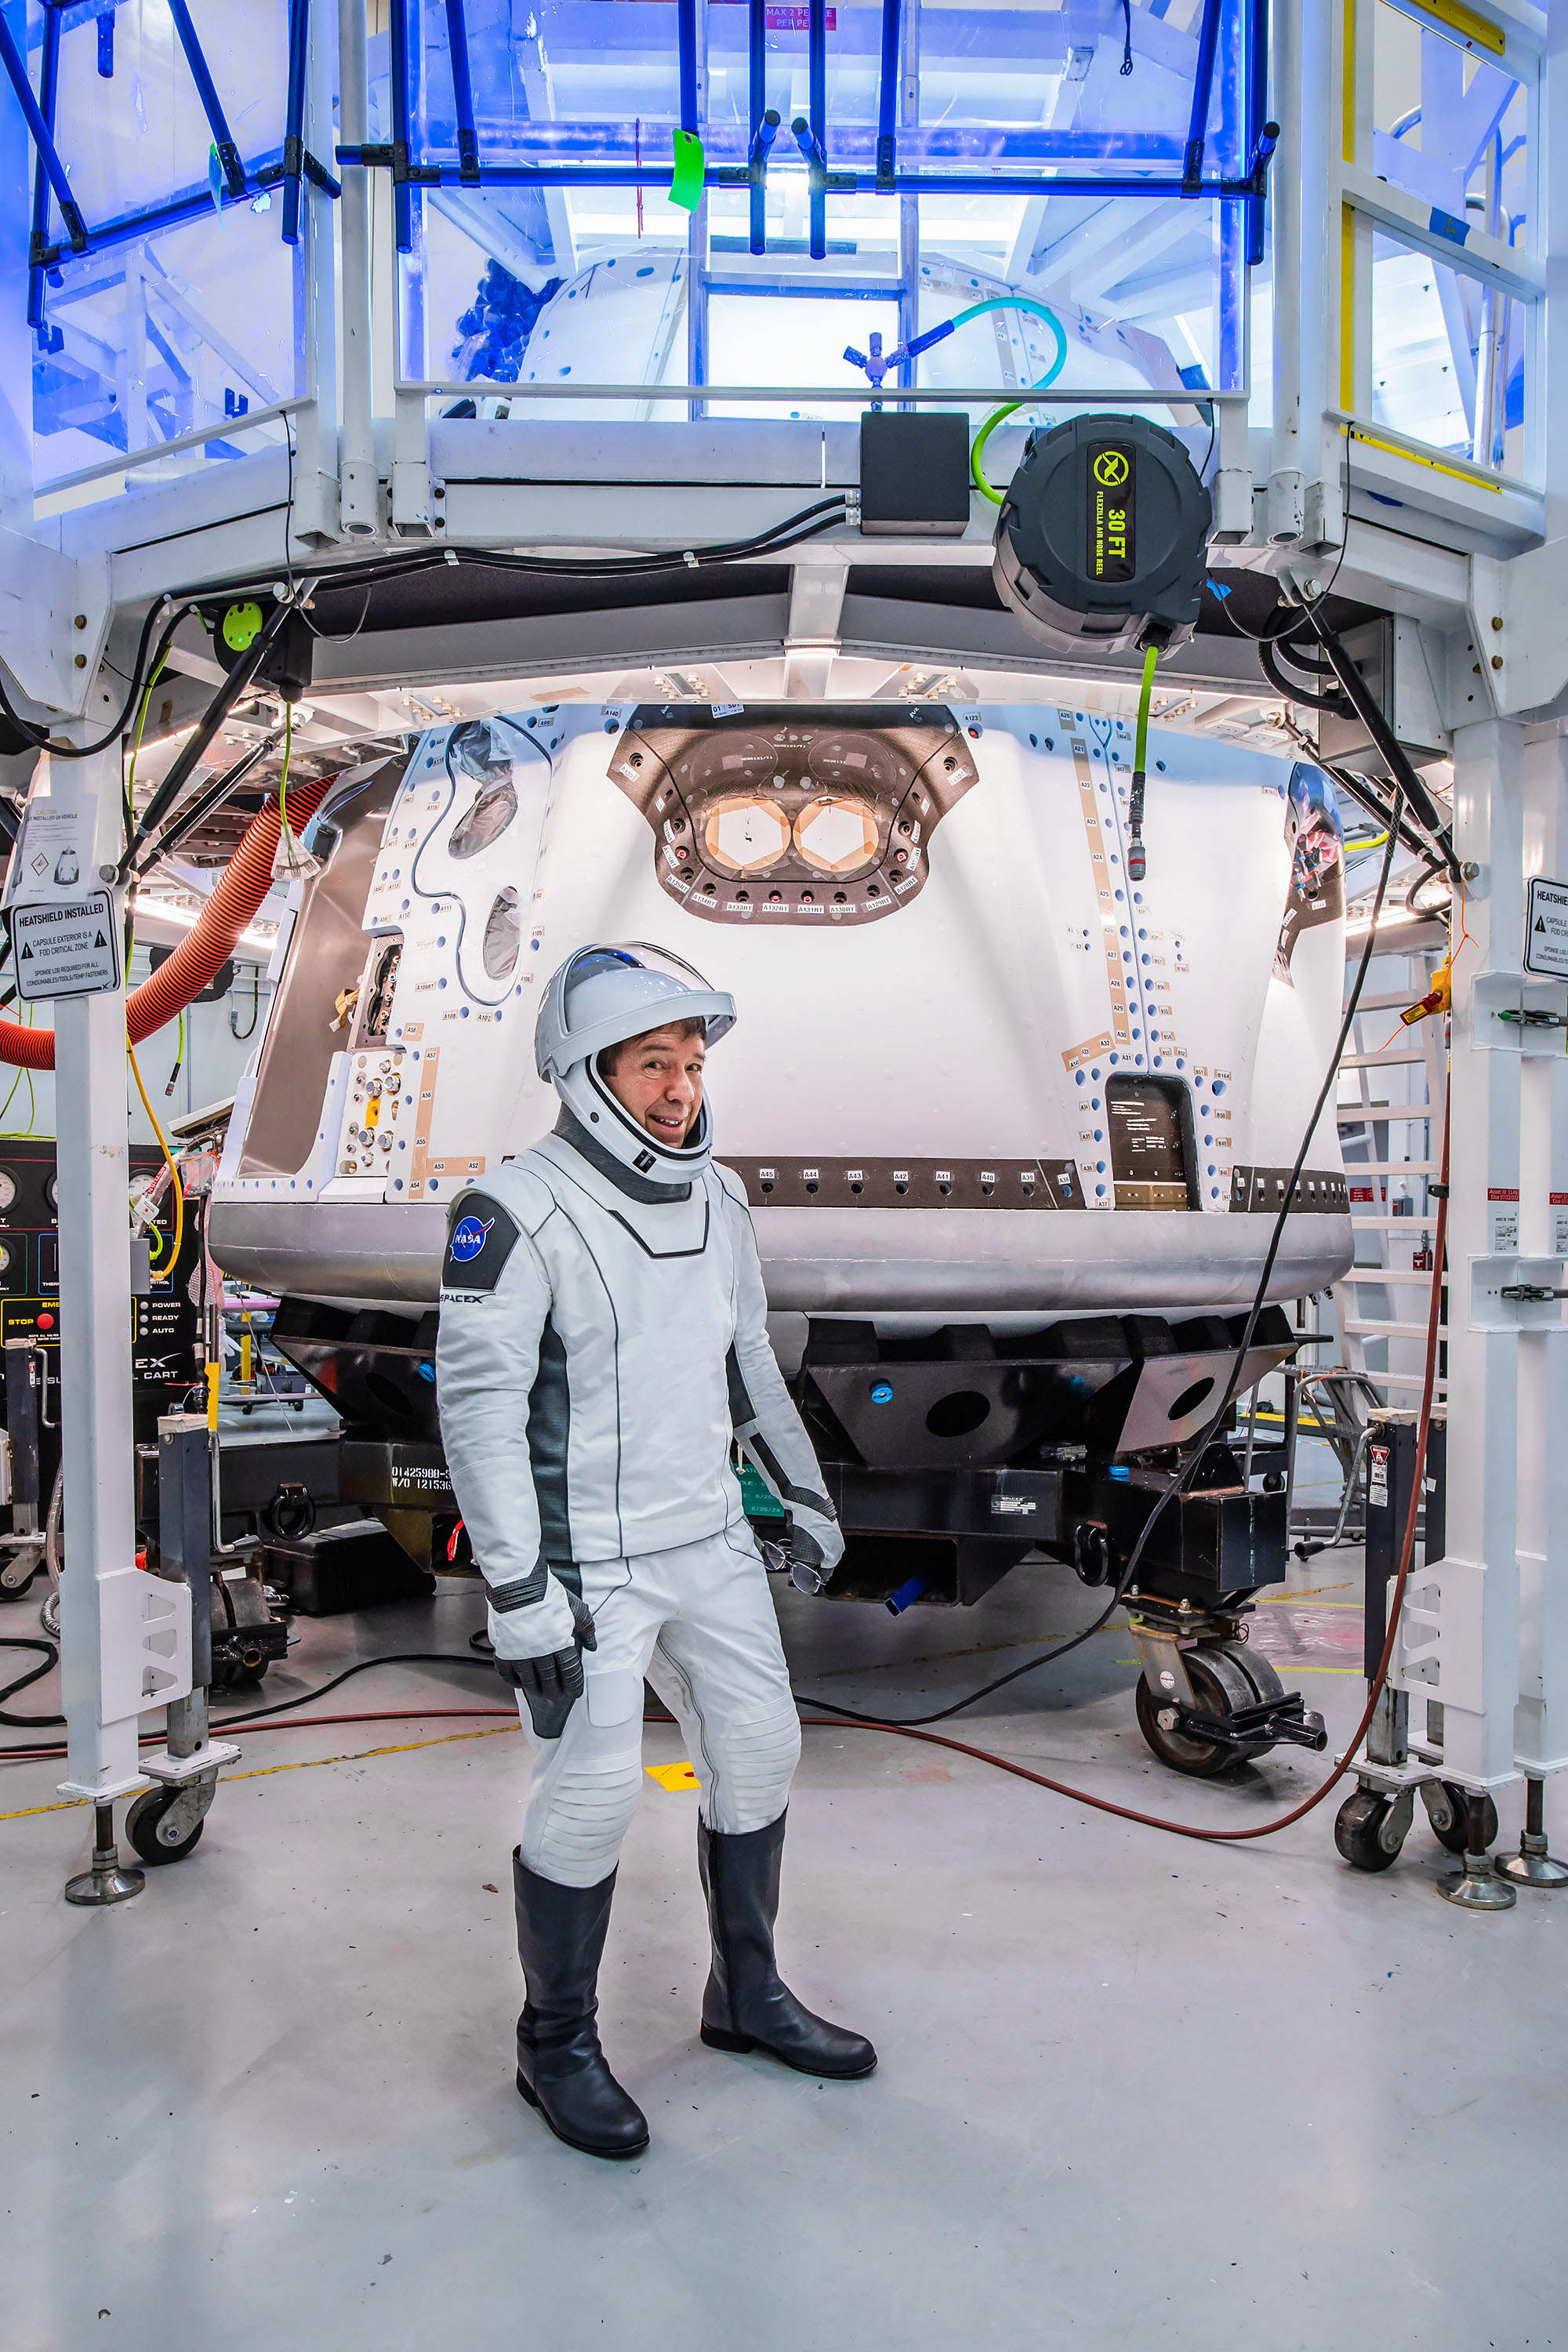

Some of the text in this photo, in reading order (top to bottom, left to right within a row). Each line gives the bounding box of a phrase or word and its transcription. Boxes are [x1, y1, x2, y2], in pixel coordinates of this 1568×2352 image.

[766, 8, 787, 16] MAX
[789, 8, 795, 16] 2
[1108, 509, 1126, 558] 30 FT
[668, 877, 688, 892] A135RT
[896, 878, 916, 894] A128RT
[692, 895, 715, 907] A134RT
[867, 898, 890, 909] A129RT
[1537, 891, 1568, 906] HEATSHIE
[20, 903, 103, 927] HEATSHIELD INSTALLED
[1546, 916, 1567, 927] CAPSULE
[1551, 927, 1561, 936] FOD
[32, 937, 56, 948] CAPSULE
[57, 933, 82, 943] EXTERIOR
[51, 945, 74, 955] CRITICAL
[74, 942, 89, 951] ZONE
[1536, 953, 1568, 964] CONSUMABLES/TO
[61, 964, 82, 972] REQUIRED
[27, 969, 108, 987] CONSUMABLES/TOOLS/TEMP FASTENERS
[455, 1234, 481, 1244] NASA
[440, 1294, 496, 1304] SPACEX
